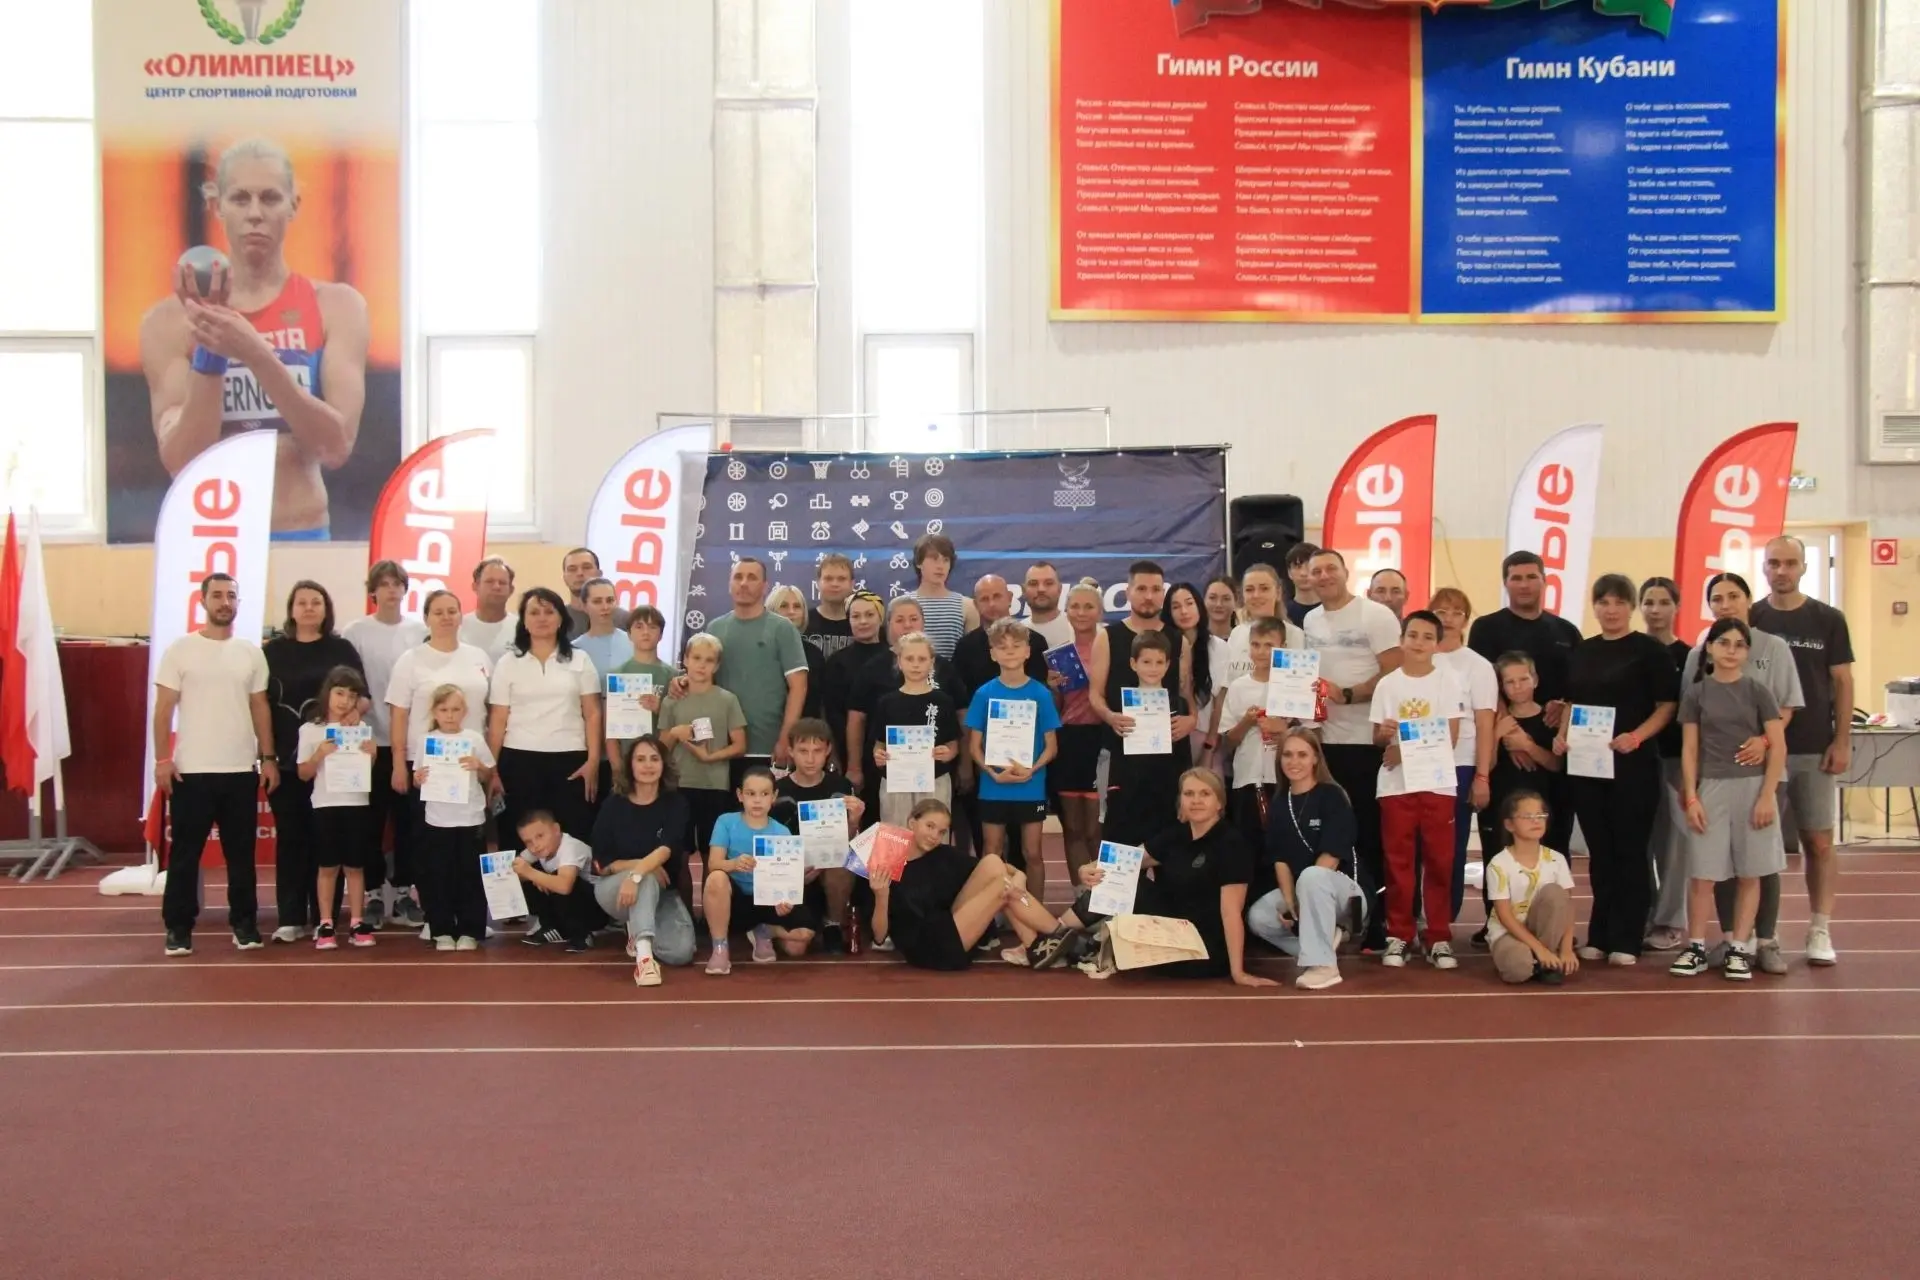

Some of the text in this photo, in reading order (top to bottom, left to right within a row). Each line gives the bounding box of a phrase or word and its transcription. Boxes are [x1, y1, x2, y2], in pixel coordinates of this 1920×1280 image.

[143, 53, 355, 82] «ОЛИМПИЕЦ»
[1157, 53, 1319, 78] Гимн России
[1506, 55, 1676, 84] Гимн Кубани
[146, 86, 357, 99] ЦЕНТР СПОРТИВНОЙ ПОДГОТОВКИ
